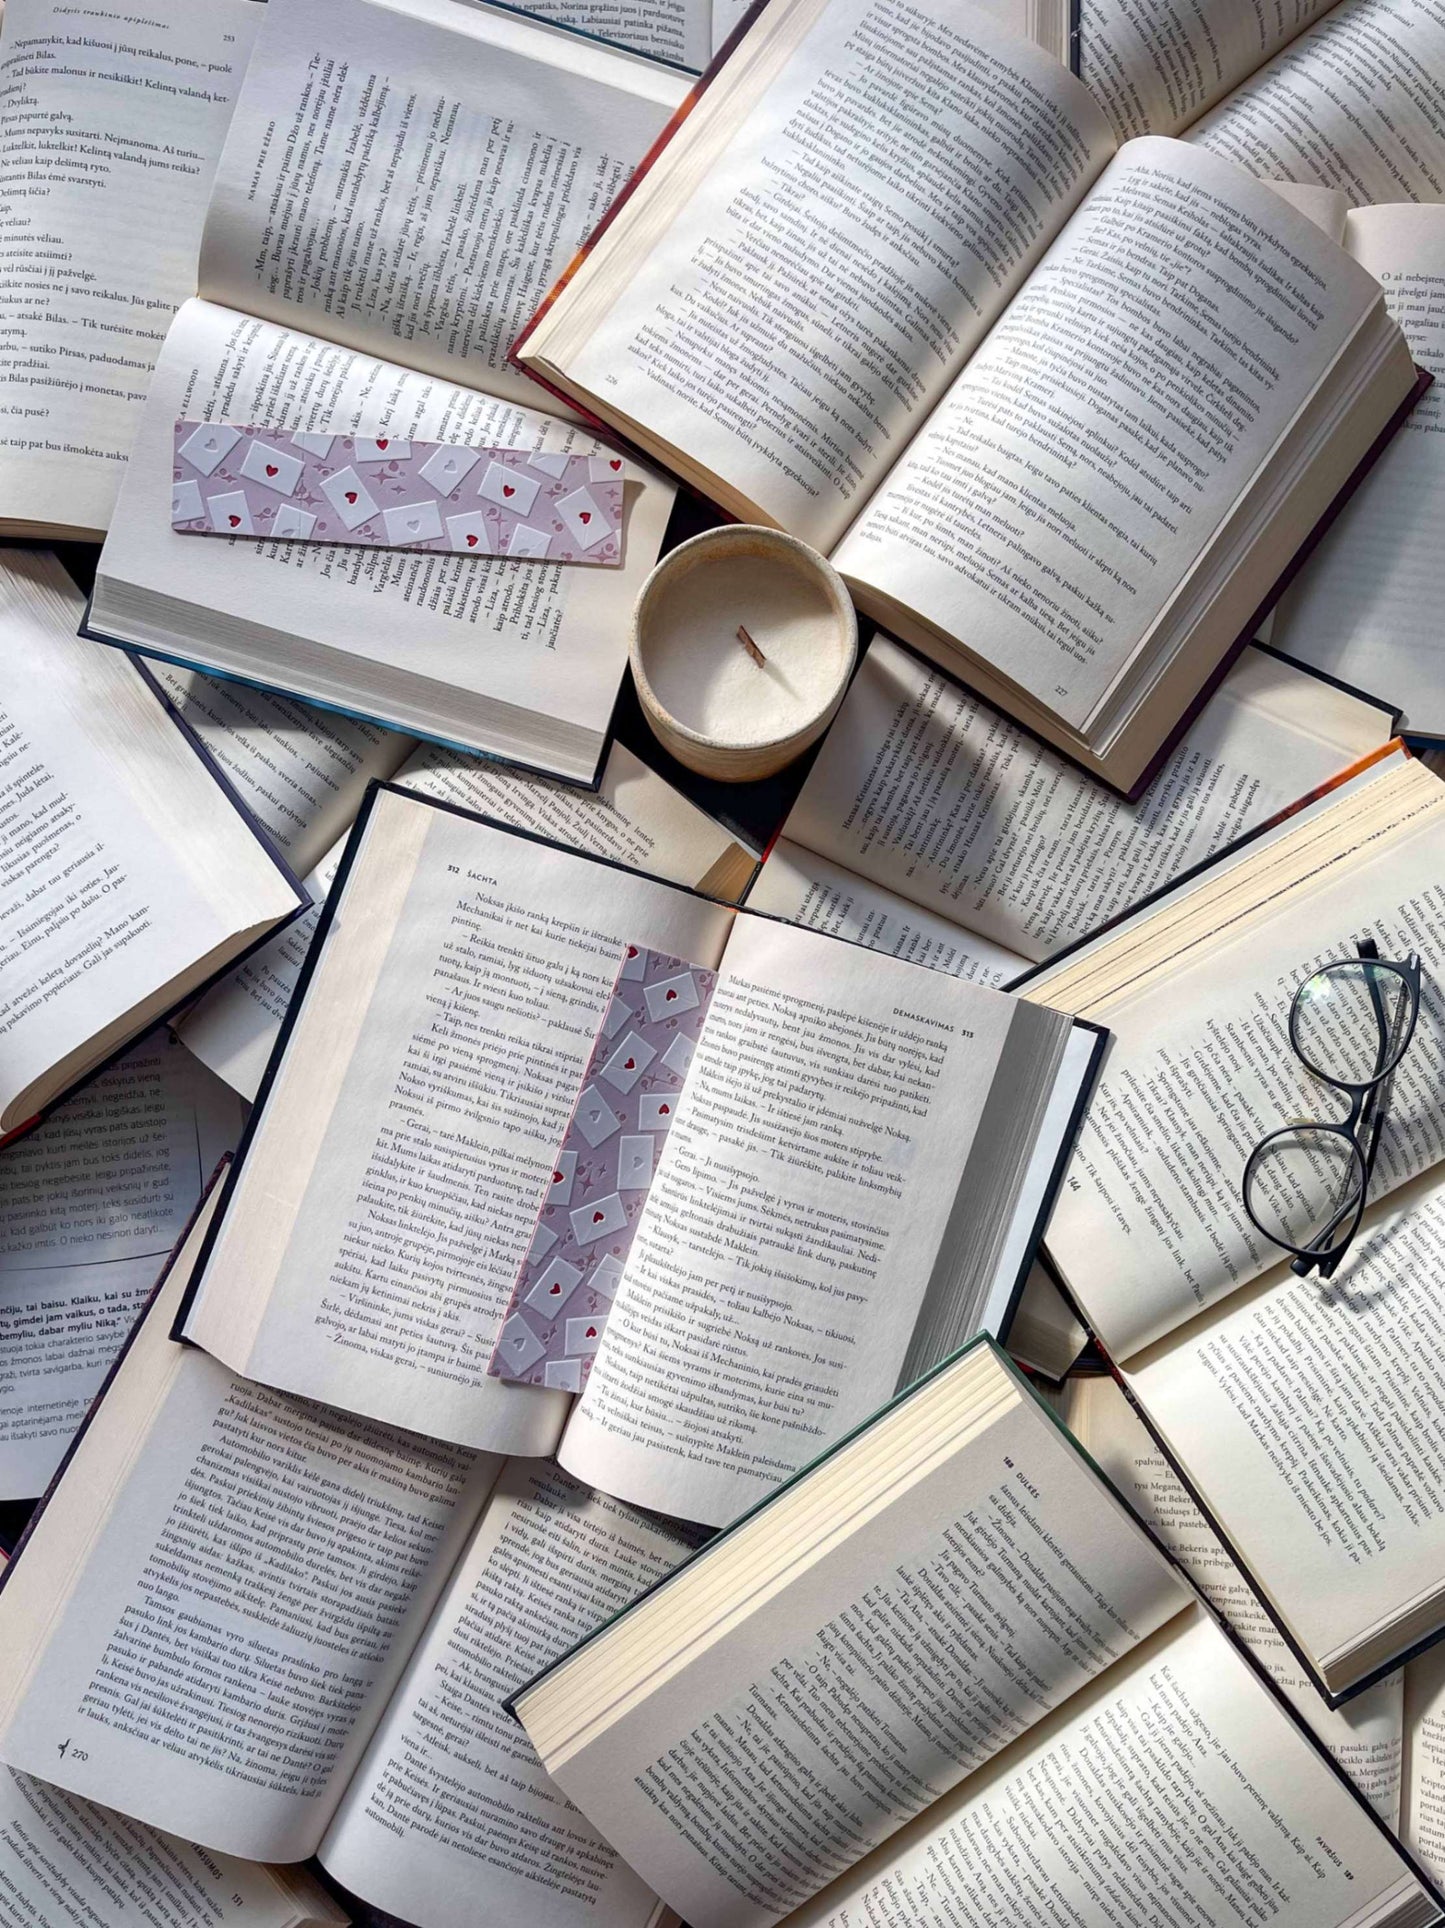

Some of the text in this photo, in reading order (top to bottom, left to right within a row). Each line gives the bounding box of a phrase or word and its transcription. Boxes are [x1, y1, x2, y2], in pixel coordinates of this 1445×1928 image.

[222, 34, 235, 42] 253
[50, 64, 230, 103] malonus ir nesikiškit! Kelintą valandą ket-
[247, 120, 276, 201] NAMAS PRIE EŽERO
[336, 220, 366, 305] kaip tik ėjau namo.
[1158, 264, 1220, 314] Taip pat Doganas.
[181, 368, 199, 409] ELLWOOD
[604, 373, 619, 386] 226
[712, 411, 820, 498] Semui būtų įvykdyta egzekucija?
[976, 517, 1007, 542] Letneris
[1005, 539, 1042, 567] palingavo
[1060, 579, 1086, 601] paskui
[1084, 595, 1105, 618] kažką
[1104, 613, 1116, 624] su-
[508, 568, 533, 625] Priblokšta jos
[544, 608, 564, 651] jaučiatės?
[1054, 684, 1069, 697] 227
[304, 761, 340, 792] pajuokavo
[323, 744, 356, 775] slegiančių
[276, 803, 308, 829] gydytoja
[625, 836, 636, 846] ne
[446, 863, 498, 886] 312 ŠACHTA
[1007, 834, 1047, 902] Ir kur ji pradingo?
[1019, 838, 1062, 908] Kaip tik čia ir esam,
[474, 891, 623, 947] Noksas įkišo ranką krepšin ir ištraukė
[37, 905, 150, 986] keletą dovanėlių? Mano kam-
[82, 953, 102, 970] Gali
[100, 946, 114, 960] jas
[112, 919, 153, 949] supakuoti.
[771, 1002, 797, 1021] Noksą
[798, 1013, 827, 1027] apniko
[827, 1020, 864, 1040] abejonės.
[863, 1031, 877, 1043] Jis
[876, 1035, 897, 1052] būtų
[928, 1052, 945, 1065] kad
[892, 1007, 975, 1039] DEMASKAVIMAS 313
[1066, 1175, 1082, 1192] 144
[1085, 1161, 1098, 1178] Tik
[1093, 1176, 1114, 1205] šaiposi
[1110, 1204, 1121, 1213] iš
[1128, 1180, 1195, 1284] žengė žingsnį jos link, bet
[12, 1302, 131, 1329] gimdei jam vaikus, o tada,
[25, 1290, 132, 1312] tai baisu. Klaiku, kai su
[37, 1325, 65, 1337] dabar
[66, 1320, 93, 1334] myliu
[1015, 1471, 1040, 1499] DULKĖS
[1247, 1418, 1332, 1547] Markas neišvyko iš miesto be jos.
[941, 1528, 986, 1577] loterijos esmė?
[962, 1510, 979, 1526] Juk
[973, 1525, 998, 1550] girdėjo
[996, 1546, 1024, 1581] Turmaną
[1021, 1578, 1042, 1601] nuolat
[1177, 1543, 1209, 1553] Bekeris
[112, 1628, 257, 1694] žalvarinė bumbulo formos rankena
[70, 1748, 89, 1762] 270
[77, 1705, 267, 1787] ir lauks, anksčiau ar vėliau atvykėlis tikriausiai
[421, 1732, 451, 1755] Atleisk,
[452, 1750, 482, 1771] aukseli,
[483, 1763, 499, 1778] bet
[498, 1773, 510, 1783] aš
[509, 1777, 527, 1792] taip
[1188, 1708, 1211, 1740] užgeso,
[1207, 1736, 1222, 1750] jie
[1216, 1748, 1232, 1764] jau
[1229, 1761, 1247, 1783] buvo
[1289, 1835, 1306, 1855] Kaip
[1310, 1860, 1326, 1880] Kaip
[84, 1862, 107, 1886] kuopti
[1314, 1835, 1355, 1881] PAVIRŠIUS 189
